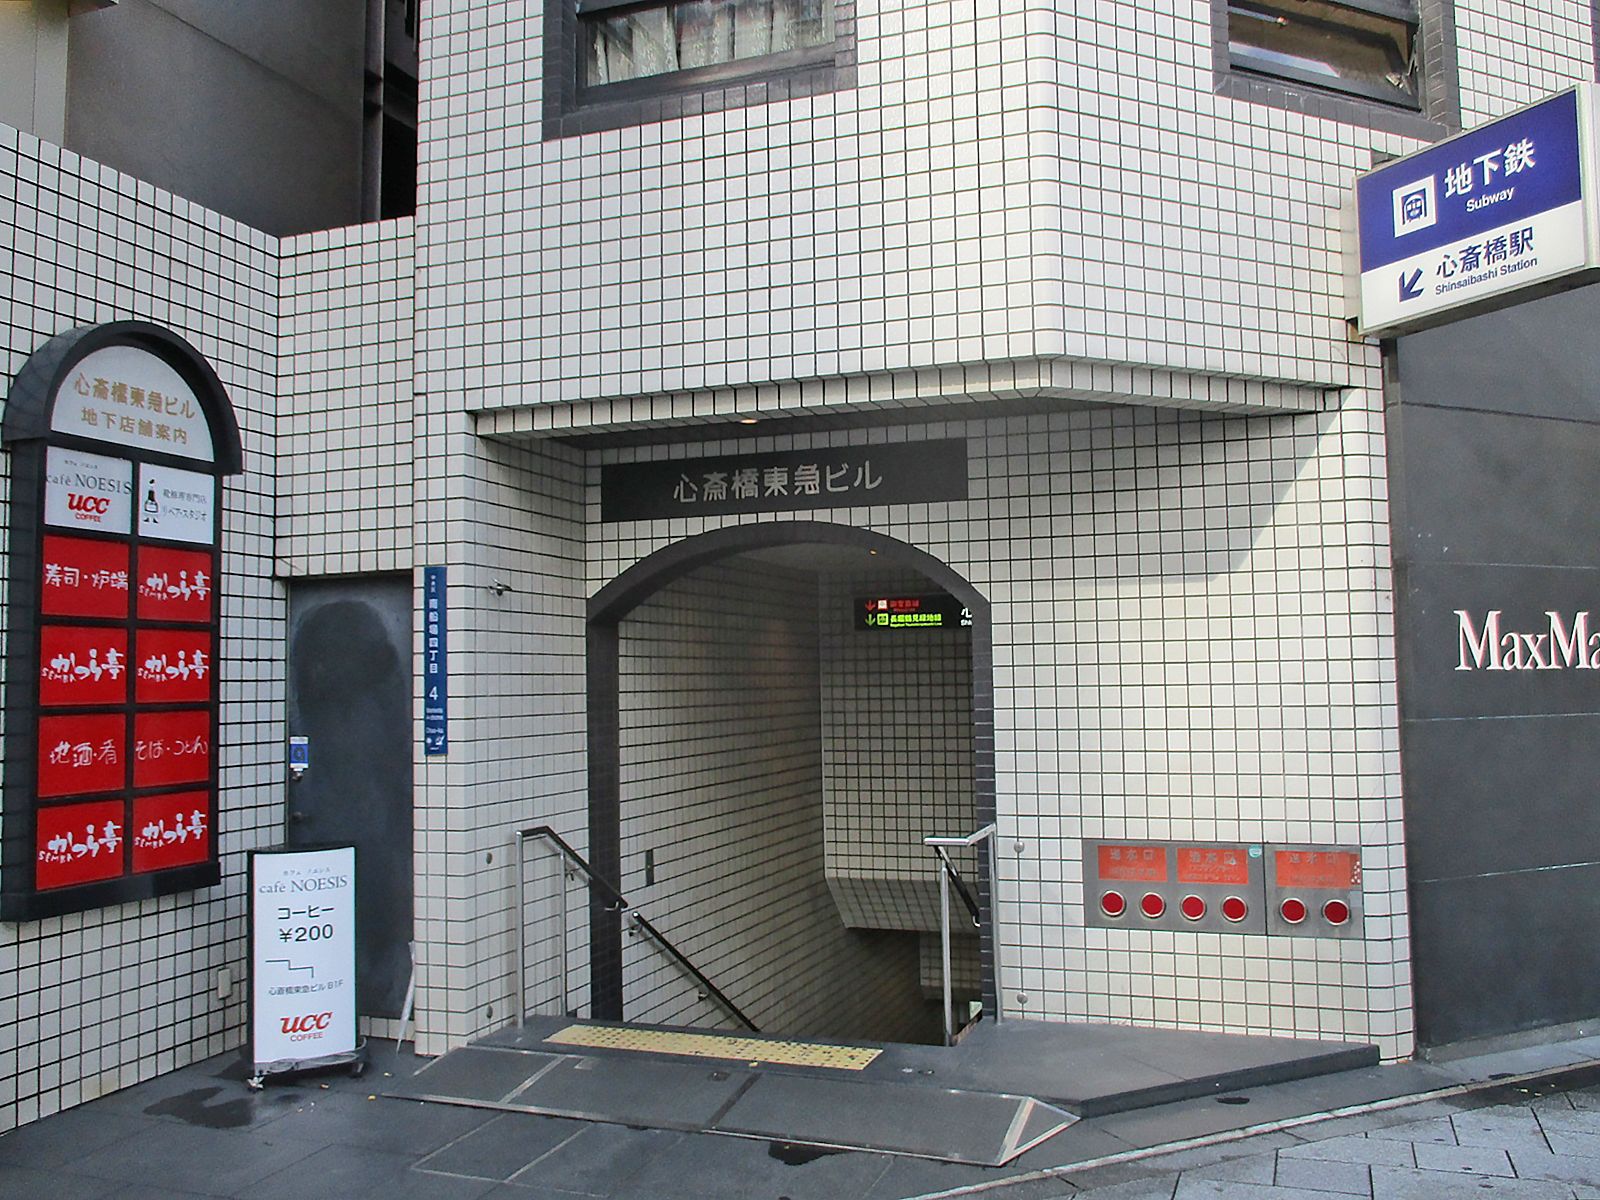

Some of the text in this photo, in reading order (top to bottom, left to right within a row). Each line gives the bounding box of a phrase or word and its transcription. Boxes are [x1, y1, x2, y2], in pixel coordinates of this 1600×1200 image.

[1444, 137, 1537, 199] 地下鉄
[1466, 186, 1516, 213] Subway
[1436, 226, 1535, 280] 心斎橋駅
[1435, 257, 1538, 296] Shinsaibashi Station
[73, 372, 196, 419] 心斎橋東急ビル
[81, 407, 188, 445] 地下店舗案内
[75, 473, 133, 496] NOESIS
[673, 459, 884, 503] 心斎橋東急ビル
[75, 513, 101, 523] COFFEE
[41, 667, 77, 683] SEMBA
[429, 686, 439, 700] 4
[38, 849, 74, 864] SEMBA
[290, 875, 348, 893] NOESIS
[278, 904, 335, 920] コーヒー
[279, 924, 334, 943] ¥200
[326, 979, 344, 991] B1F
[290, 1032, 324, 1042] COFFEE
